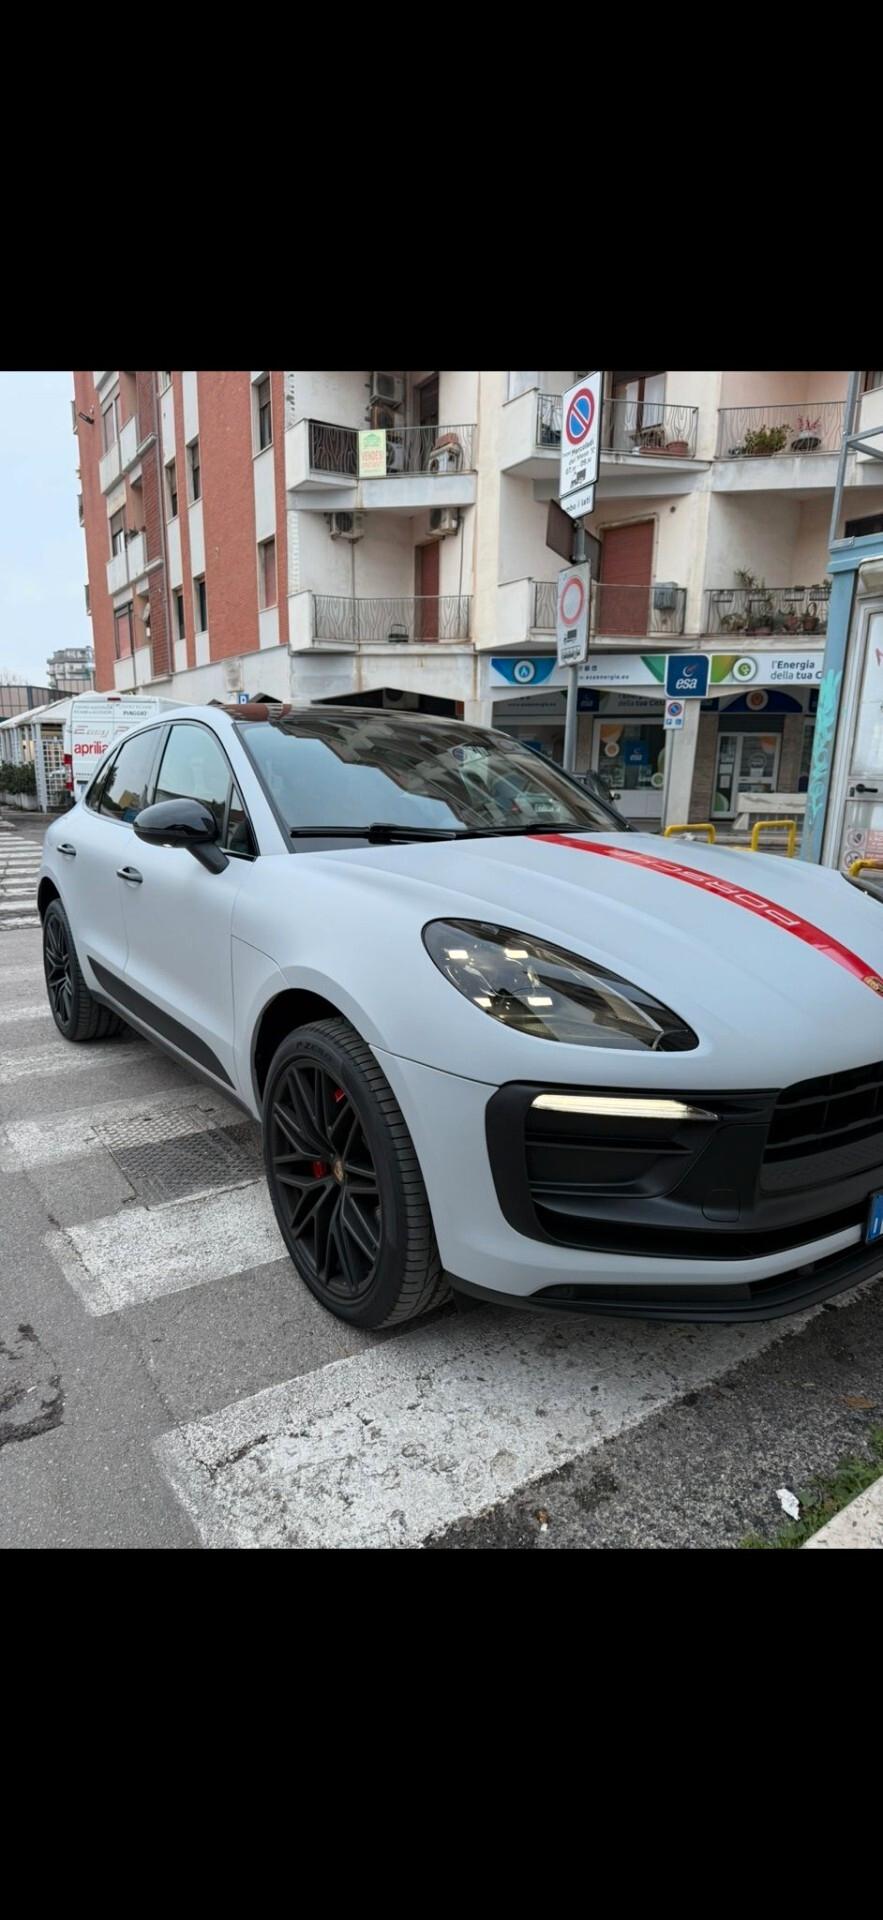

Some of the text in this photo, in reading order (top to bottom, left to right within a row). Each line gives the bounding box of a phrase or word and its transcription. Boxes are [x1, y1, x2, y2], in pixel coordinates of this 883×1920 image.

[771, 659, 815, 670] l'Energia
[770, 669, 793, 680] della
[796, 671, 813, 680] tua
[675, 678, 698, 690] esa
